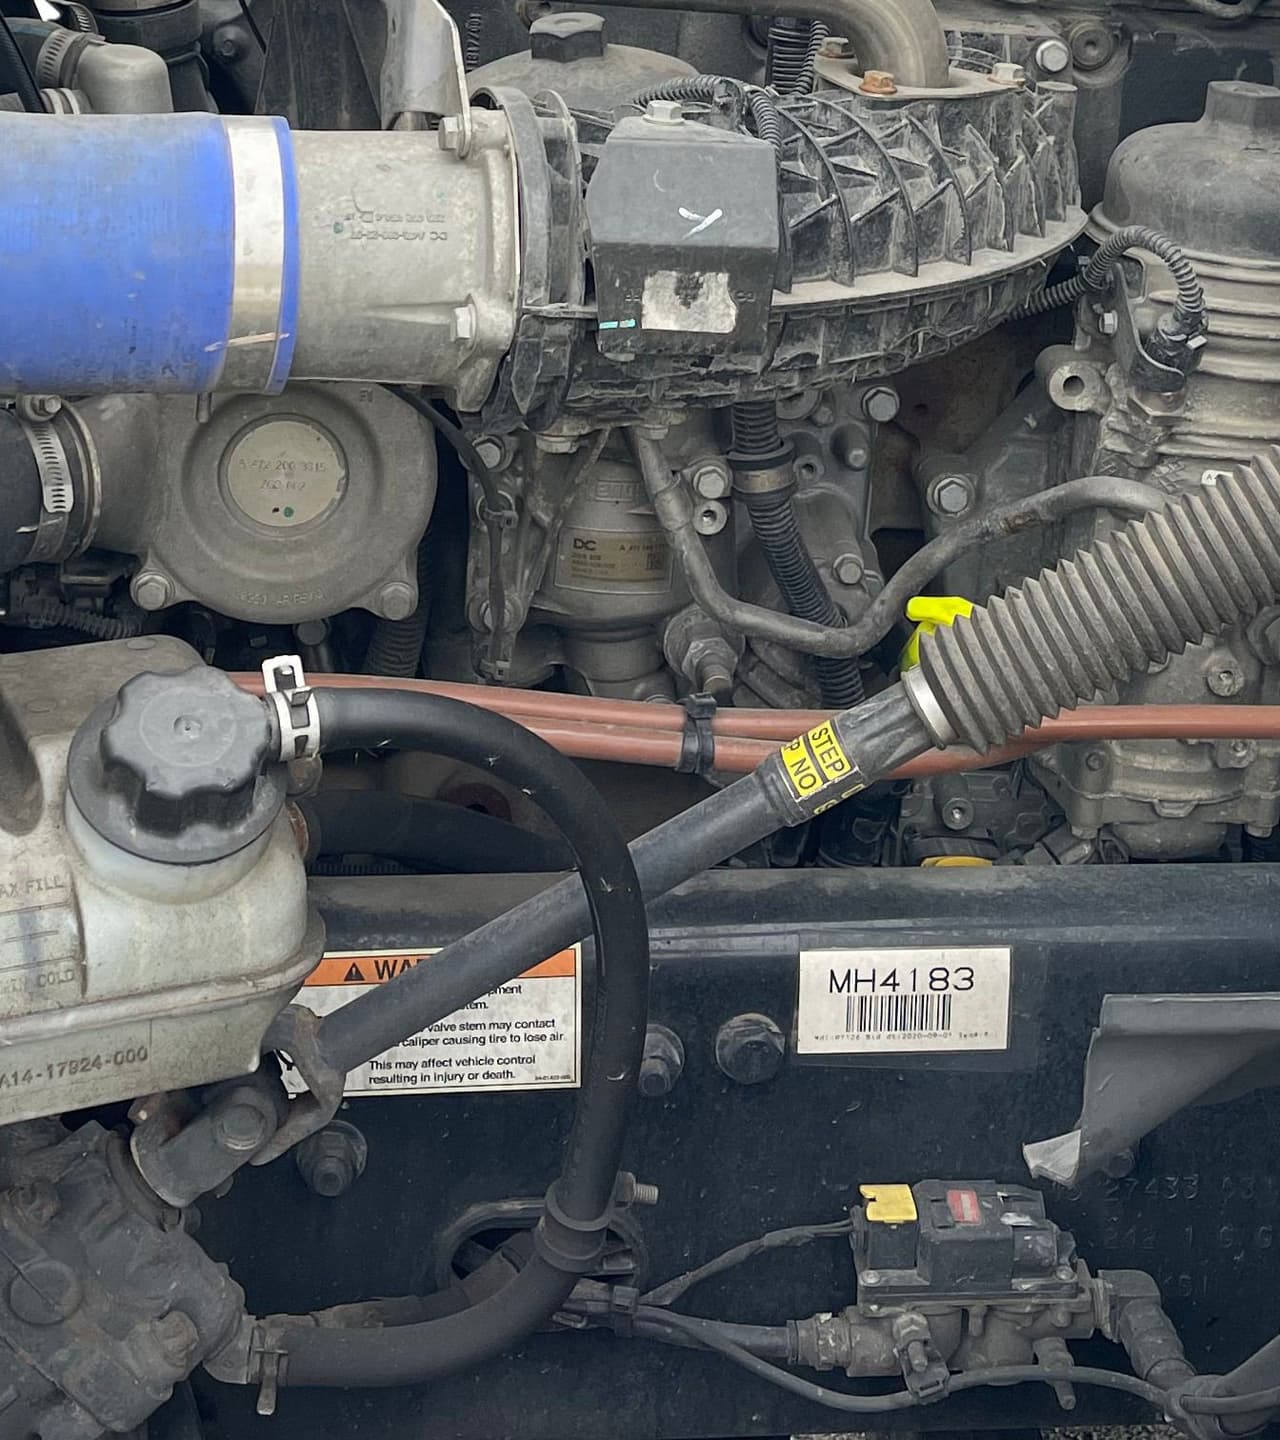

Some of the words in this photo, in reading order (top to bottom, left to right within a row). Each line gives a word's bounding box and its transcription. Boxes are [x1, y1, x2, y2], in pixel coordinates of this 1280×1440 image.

[573, 538, 596, 551] DC
[812, 727, 845, 772] STEP
[790, 757, 817, 791] NO
[25, 875, 65, 893] FILL
[37, 969, 75, 987] COLD
[829, 967, 974, 994] MH4183
[428, 1021, 456, 1032] valve
[459, 1020, 486, 1031] stem
[489, 1021, 512, 1033] may
[515, 1019, 555, 1029] contact
[402, 1035, 439, 1048] caliper
[442, 1033, 486, 1047] causing
[489, 1033, 507, 1043] tire
[510, 1033, 521, 1043] to
[524, 1032, 548, 1042] lose
[549, 1032, 567, 1041] air.
[369, 1060, 392, 1071] This
[395, 1061, 418, 1073] may
[421, 1058, 452, 1069] affect
[455, 1057, 494, 1067] vehicle
[497, 1055, 535, 1065] control
[369, 1074, 417, 1086] resulting
[420, 1073, 430, 1082] in
[434, 1072, 464, 1084] injury
[467, 1072, 479, 1080] or
[482, 1070, 516, 1080] death.
